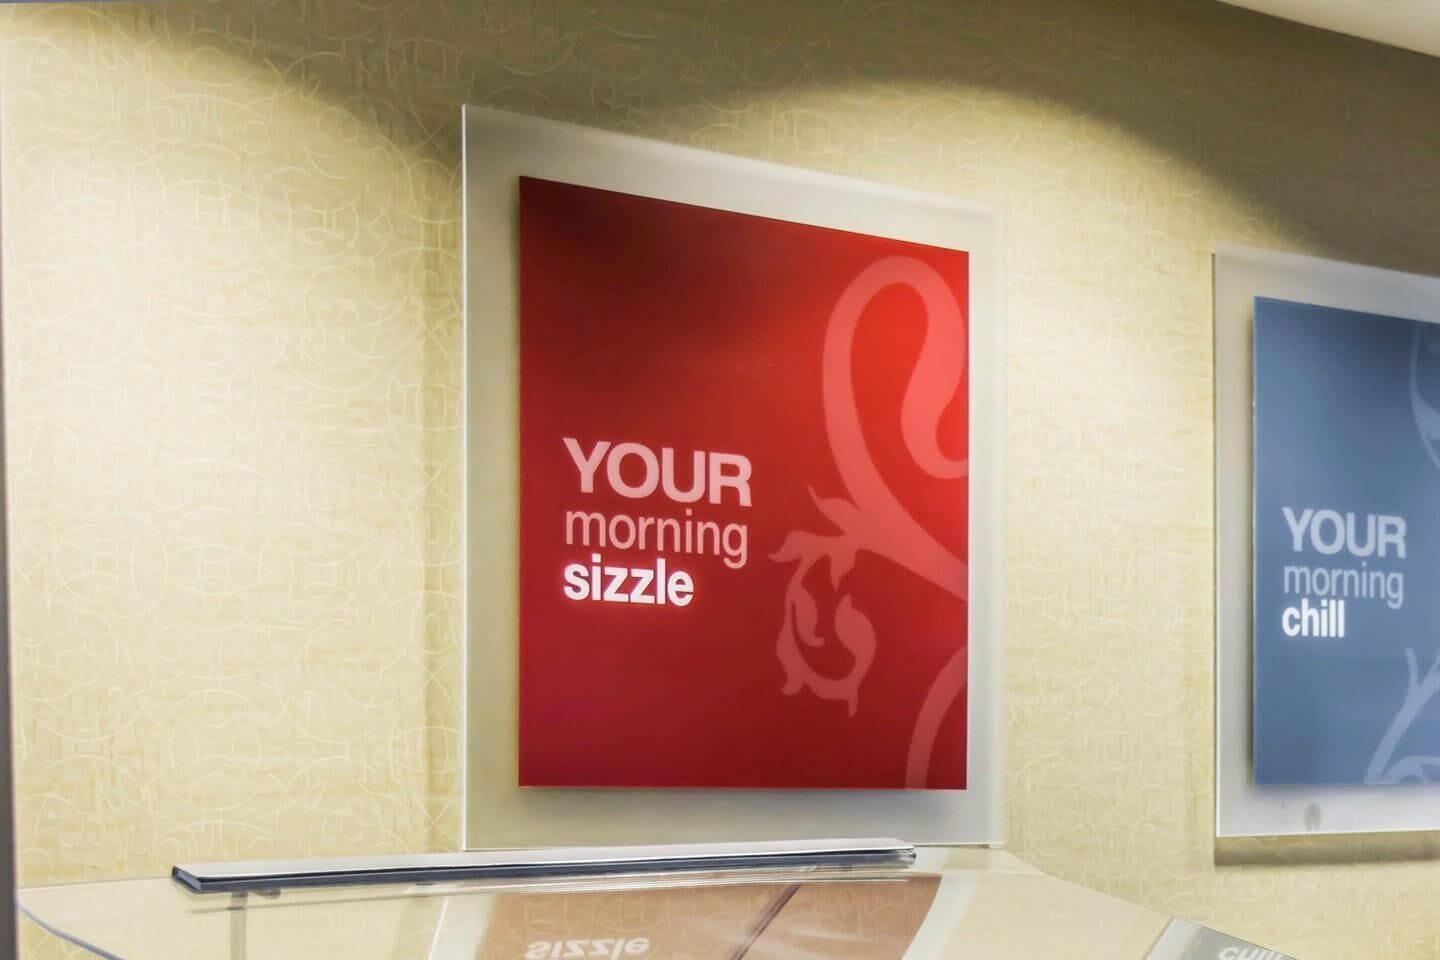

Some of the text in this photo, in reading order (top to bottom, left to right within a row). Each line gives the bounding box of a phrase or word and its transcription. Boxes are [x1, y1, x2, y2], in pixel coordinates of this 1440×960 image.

[563, 438, 753, 507] YOUR
[565, 509, 749, 569] morning
[1282, 507, 1406, 559] YOUR
[563, 554, 694, 607] sizzle
[1284, 561, 1404, 610] morning
[1282, 598, 1345, 637] chill
